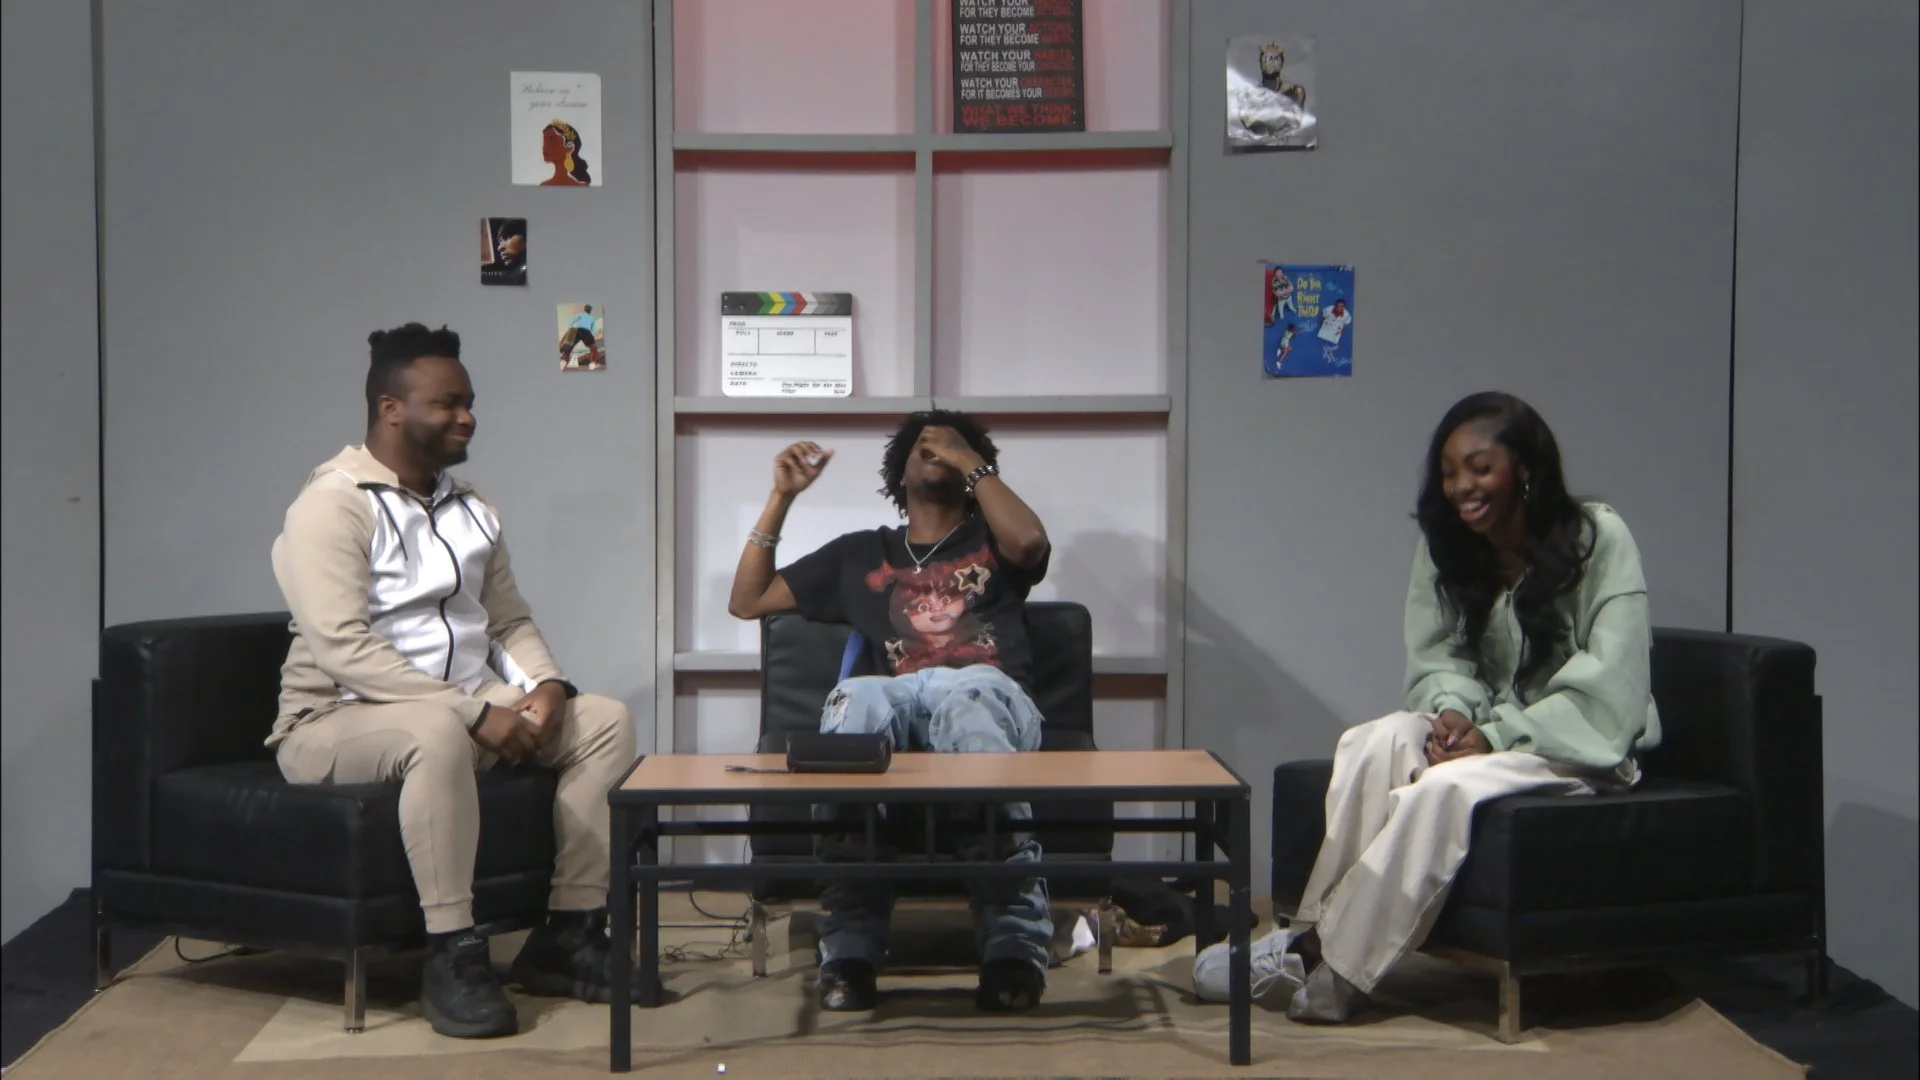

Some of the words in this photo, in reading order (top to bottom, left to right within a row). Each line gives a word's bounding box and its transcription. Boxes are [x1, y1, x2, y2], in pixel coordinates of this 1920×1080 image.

[960, 8, 976, 18] FOR
[979, 8, 998, 18] THEY
[1001, 7, 1034, 18] BECOME
[960, 24, 995, 34] WATCH
[999, 23, 1026, 34] YOUR
[960, 35, 977, 45] FOR
[980, 35, 1001, 45] THEY
[1004, 34, 1039, 45] BECOME
[960, 51, 998, 61] WATCH
[1002, 50, 1031, 60] YOUR
[961, 61, 973, 72] FOR
[975, 61, 990, 72] THEY
[991, 61, 1017, 72] BECOME
[1018, 61, 1035, 72] YOUR
[961, 78, 992, 88] WATCH
[994, 77, 1018, 88] YOUR
[961, 89, 976, 100] FOR
[978, 89, 984, 99] IT
[986, 89, 1021, 99] BECOMES
[1023, 88, 1042, 98] YOUR
[962, 104, 1002, 115] WHAT
[1007, 104, 1027, 114] WE
[963, 115, 988, 126] WE
